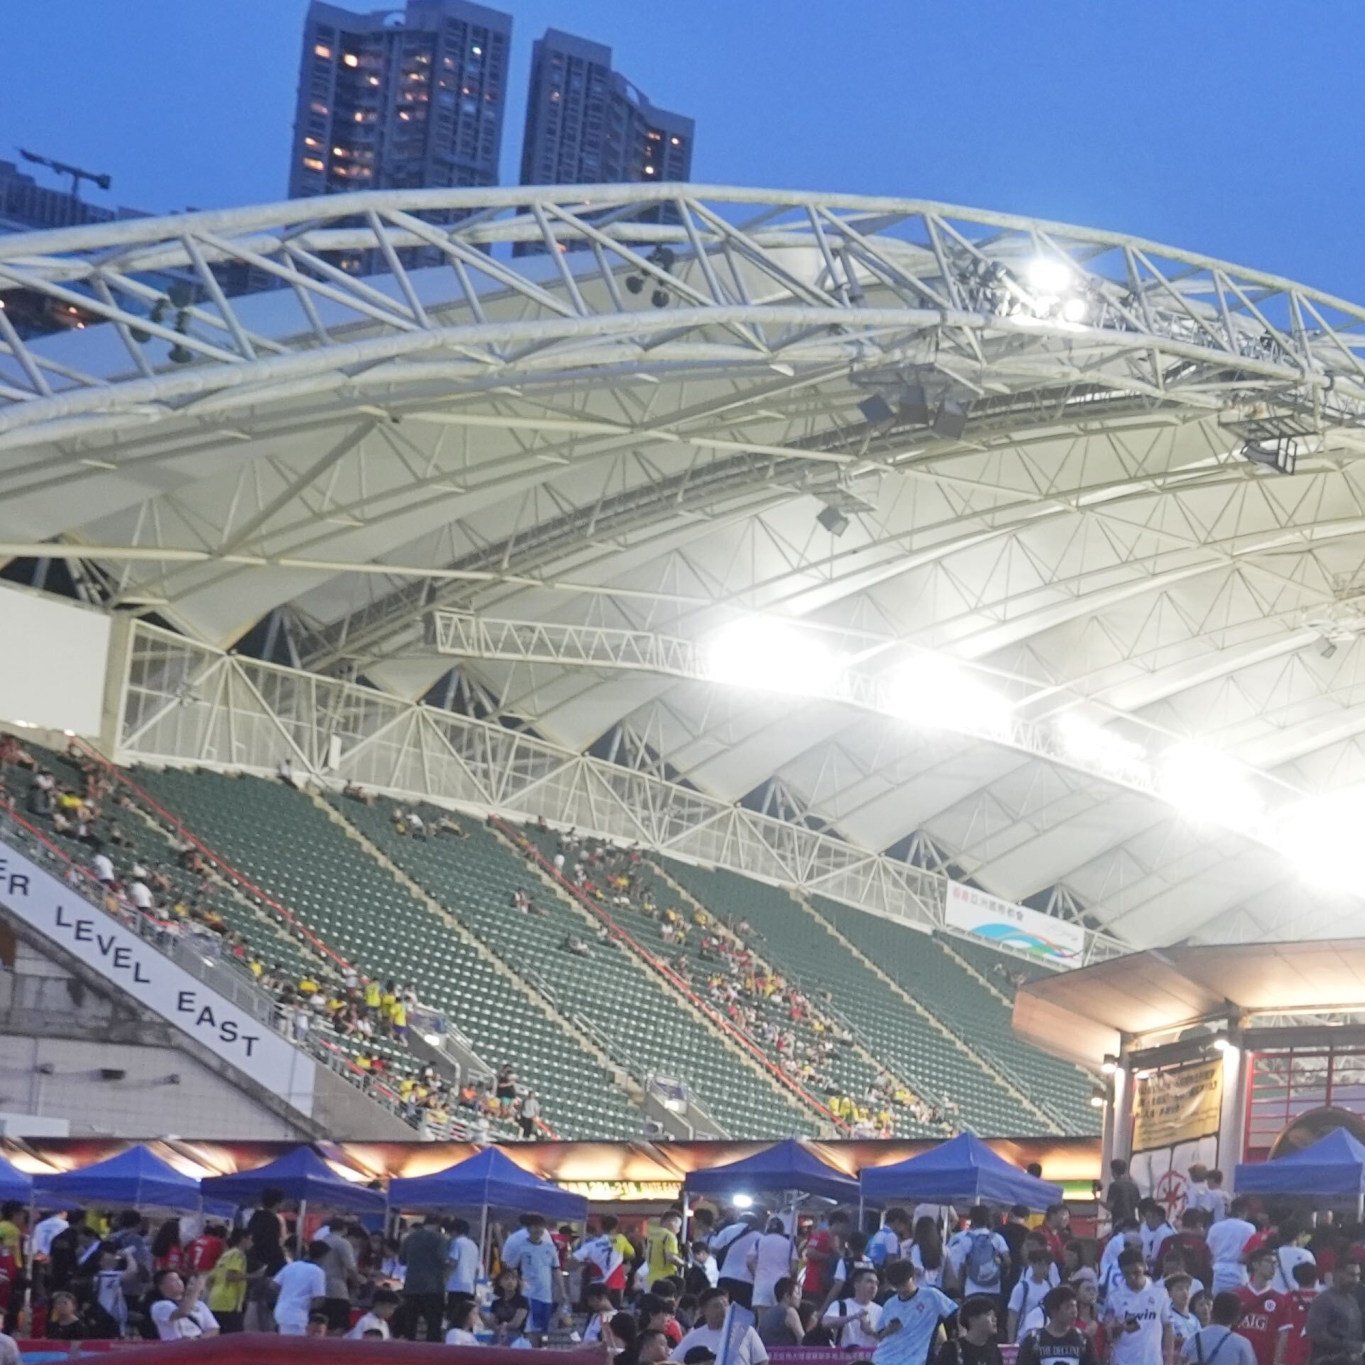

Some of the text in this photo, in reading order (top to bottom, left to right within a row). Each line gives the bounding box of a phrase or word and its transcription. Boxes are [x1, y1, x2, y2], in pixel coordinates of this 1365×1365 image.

[55, 905, 152, 983] LEVEL
[177, 990, 260, 1057] EAST
[1241, 1313, 1267, 1331] AIG
